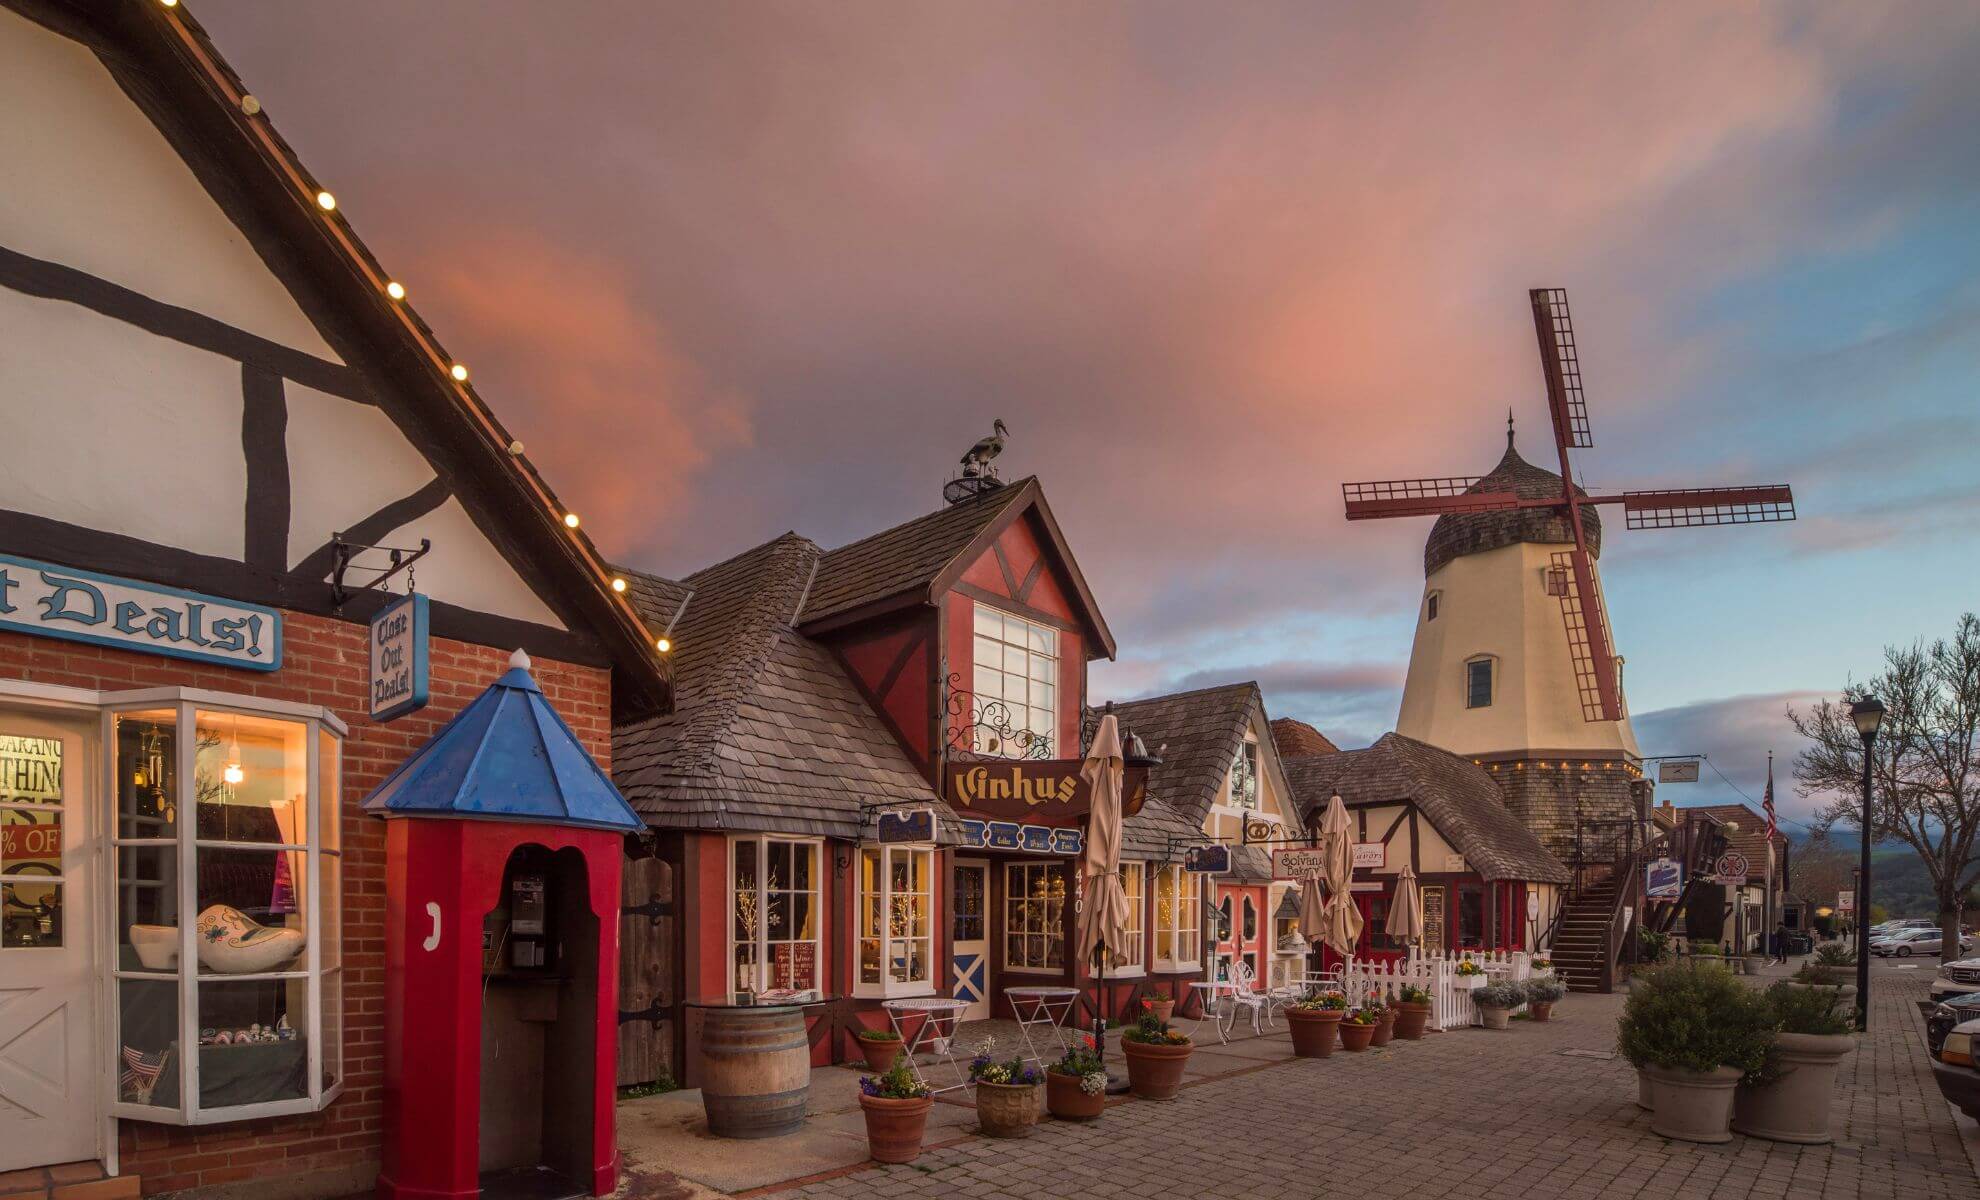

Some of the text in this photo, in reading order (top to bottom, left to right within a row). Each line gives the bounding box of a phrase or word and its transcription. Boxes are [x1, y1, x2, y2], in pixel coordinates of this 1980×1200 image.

[38, 570, 263, 657] Deals!
[377, 613, 407, 646] Close
[381, 641, 402, 673] Out
[375, 667, 410, 706] Deals!
[0, 757, 61, 793] THIN
[955, 766, 1077, 807] Vinhus
[25, 829, 61, 853] OF
[1075, 868, 1083, 913] 440
